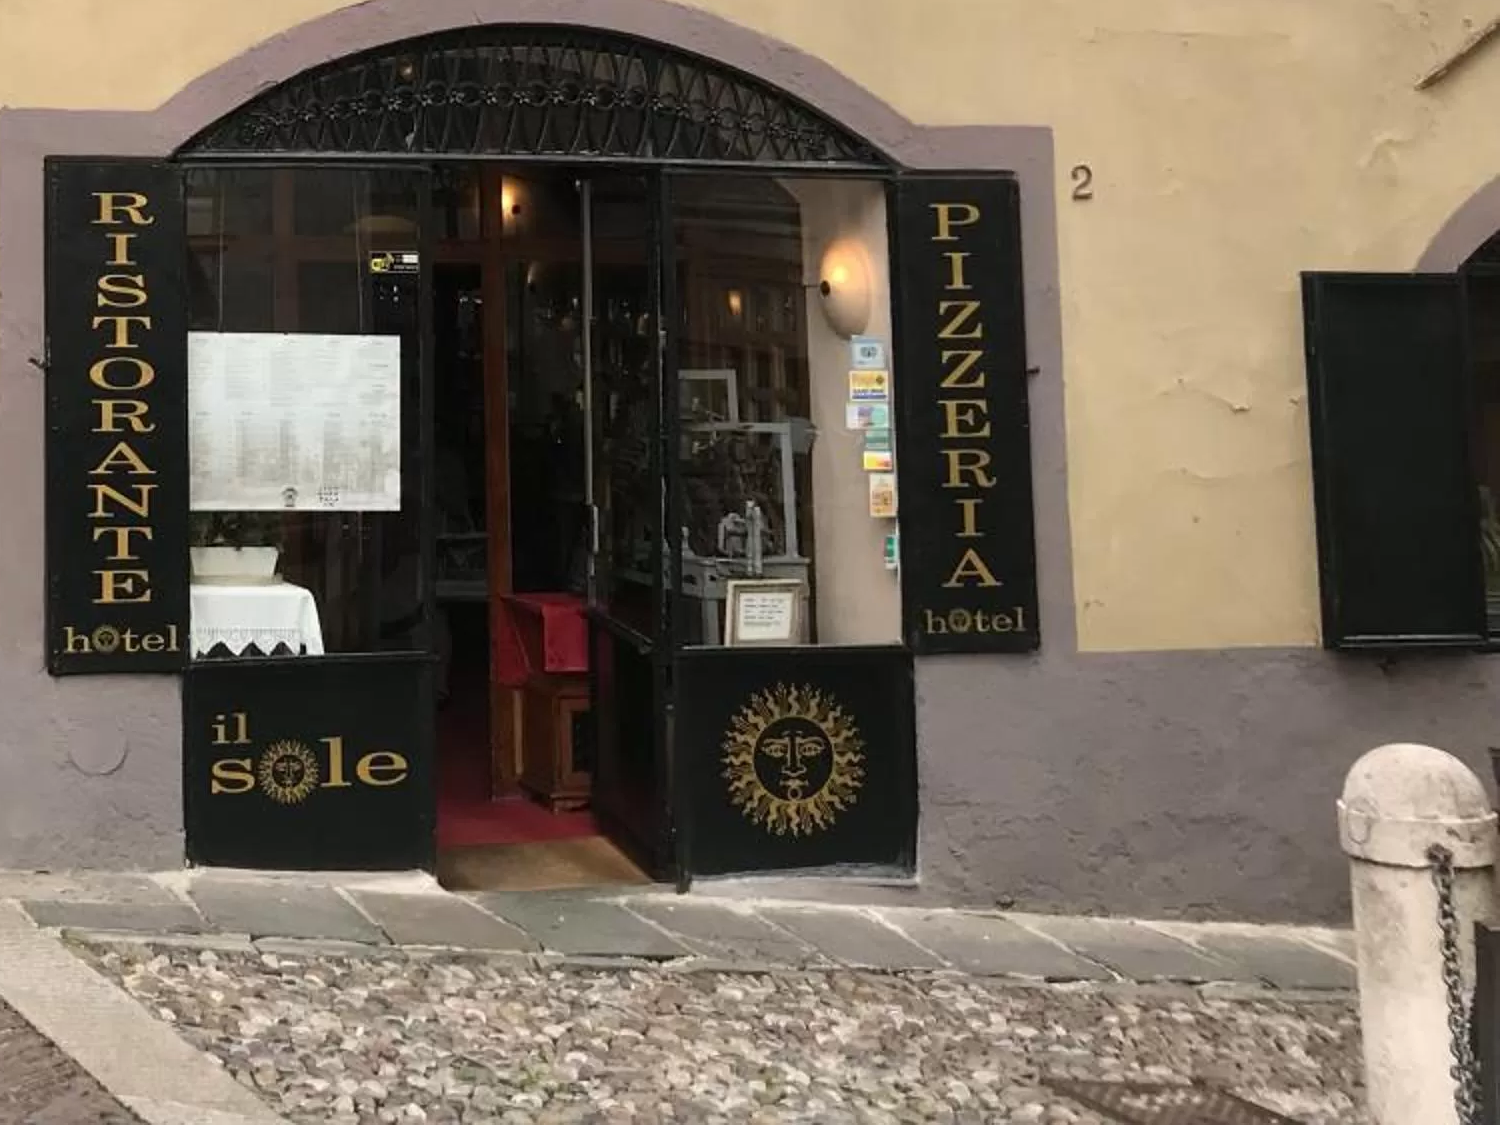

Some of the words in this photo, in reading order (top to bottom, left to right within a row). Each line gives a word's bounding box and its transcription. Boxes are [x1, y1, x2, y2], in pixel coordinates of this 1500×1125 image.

[1071, 164, 1094, 201] 2
[86, 191, 160, 605] RISTORANTE
[929, 202, 1005, 589] PIZZERIA
[210, 712, 249, 745] il
